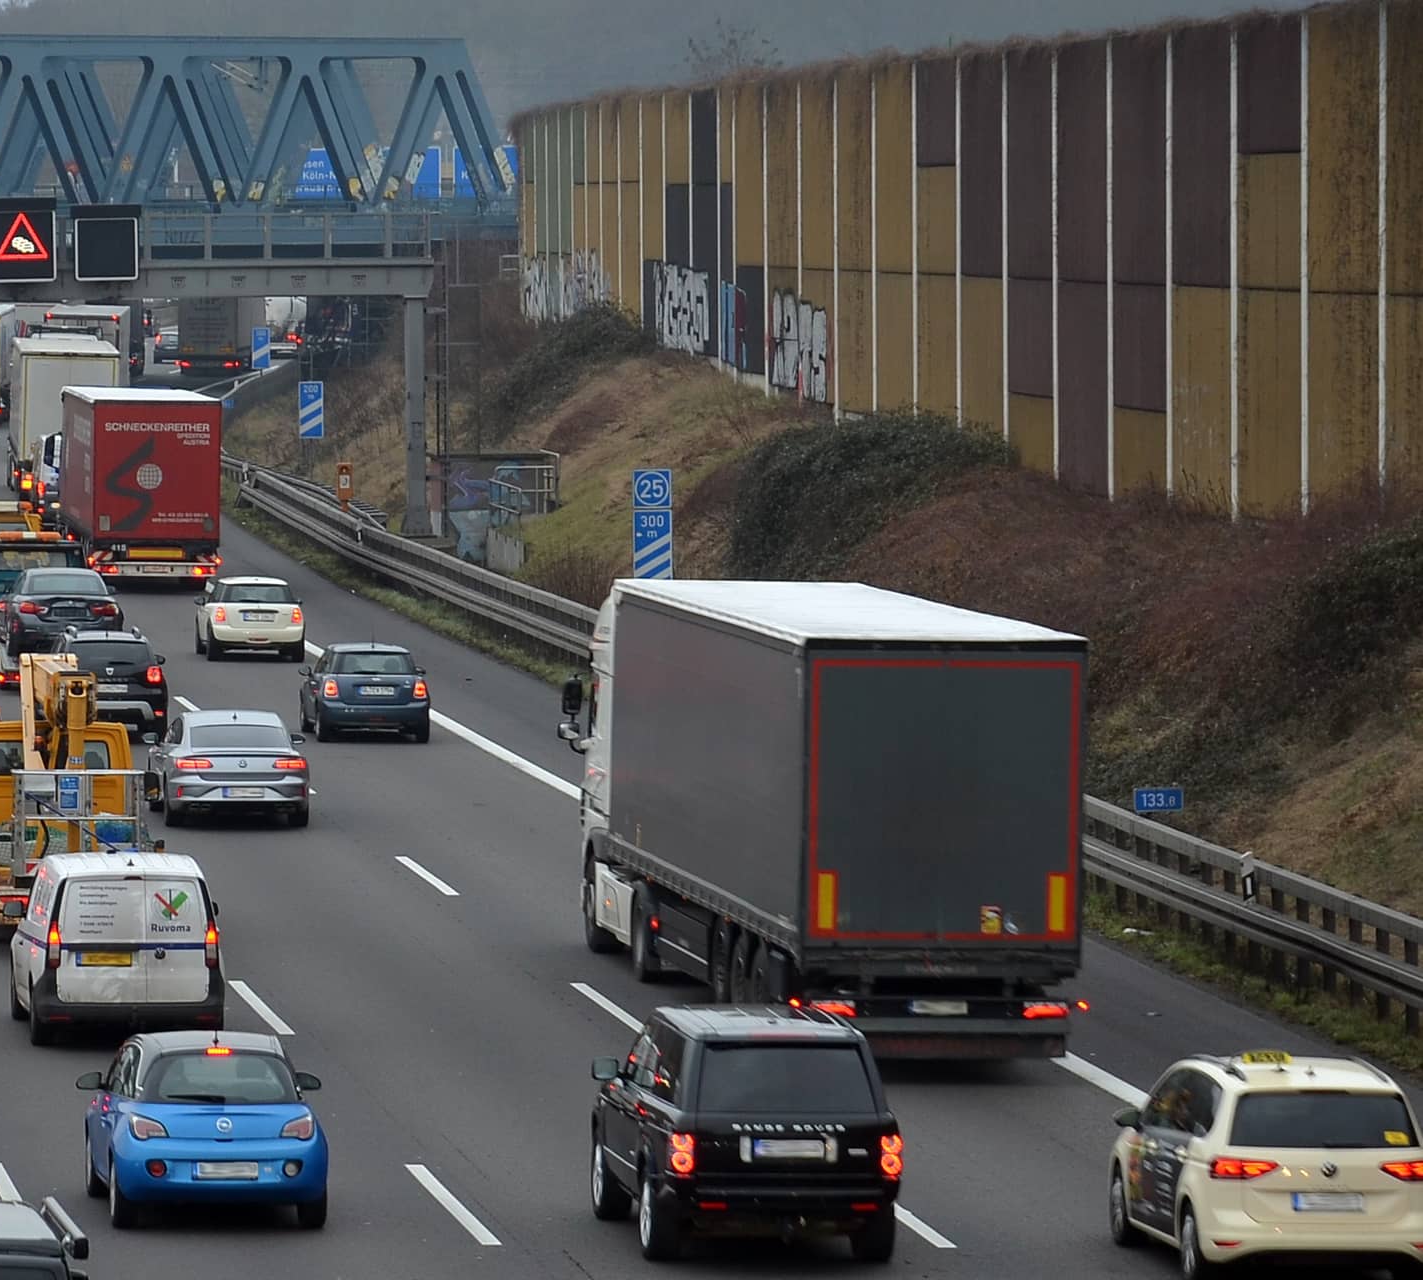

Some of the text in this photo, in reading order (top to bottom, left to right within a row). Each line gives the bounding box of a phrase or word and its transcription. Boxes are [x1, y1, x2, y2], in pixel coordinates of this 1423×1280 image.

[105, 422, 210, 432] SCHNECKENREITHER
[640, 479, 664, 499] 25
[641, 515, 664, 528] 300
[647, 530, 658, 538] m
[151, 923, 191, 933] Ruvoma
[731, 1123, 846, 1132] RANGE ROVER
